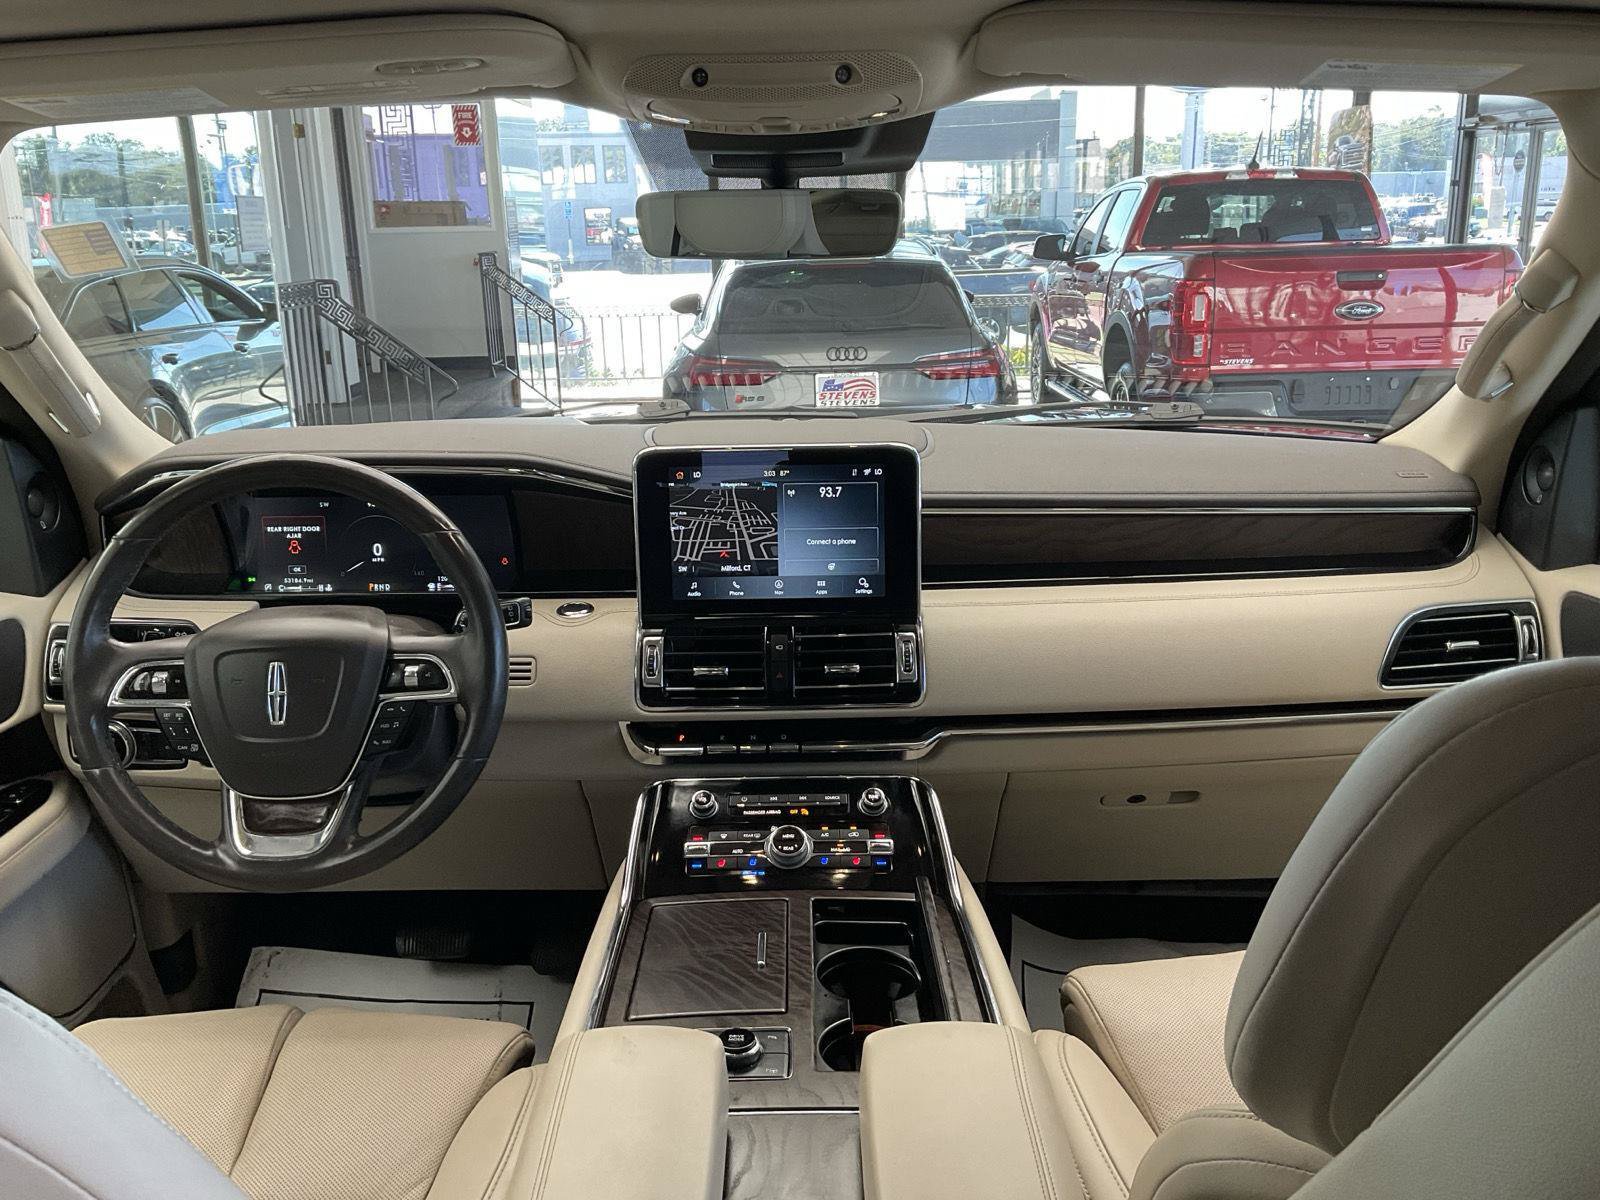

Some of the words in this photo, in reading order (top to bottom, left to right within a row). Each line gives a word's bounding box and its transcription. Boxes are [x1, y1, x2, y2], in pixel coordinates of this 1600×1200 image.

[457, 111, 473, 119] FIRE
[819, 390, 876, 400] STEVENS
[819, 486, 842, 498] 93.7
[806, 538, 830, 546] Connect
[838, 538, 857, 547] phone
[373, 543, 382, 556] 0
